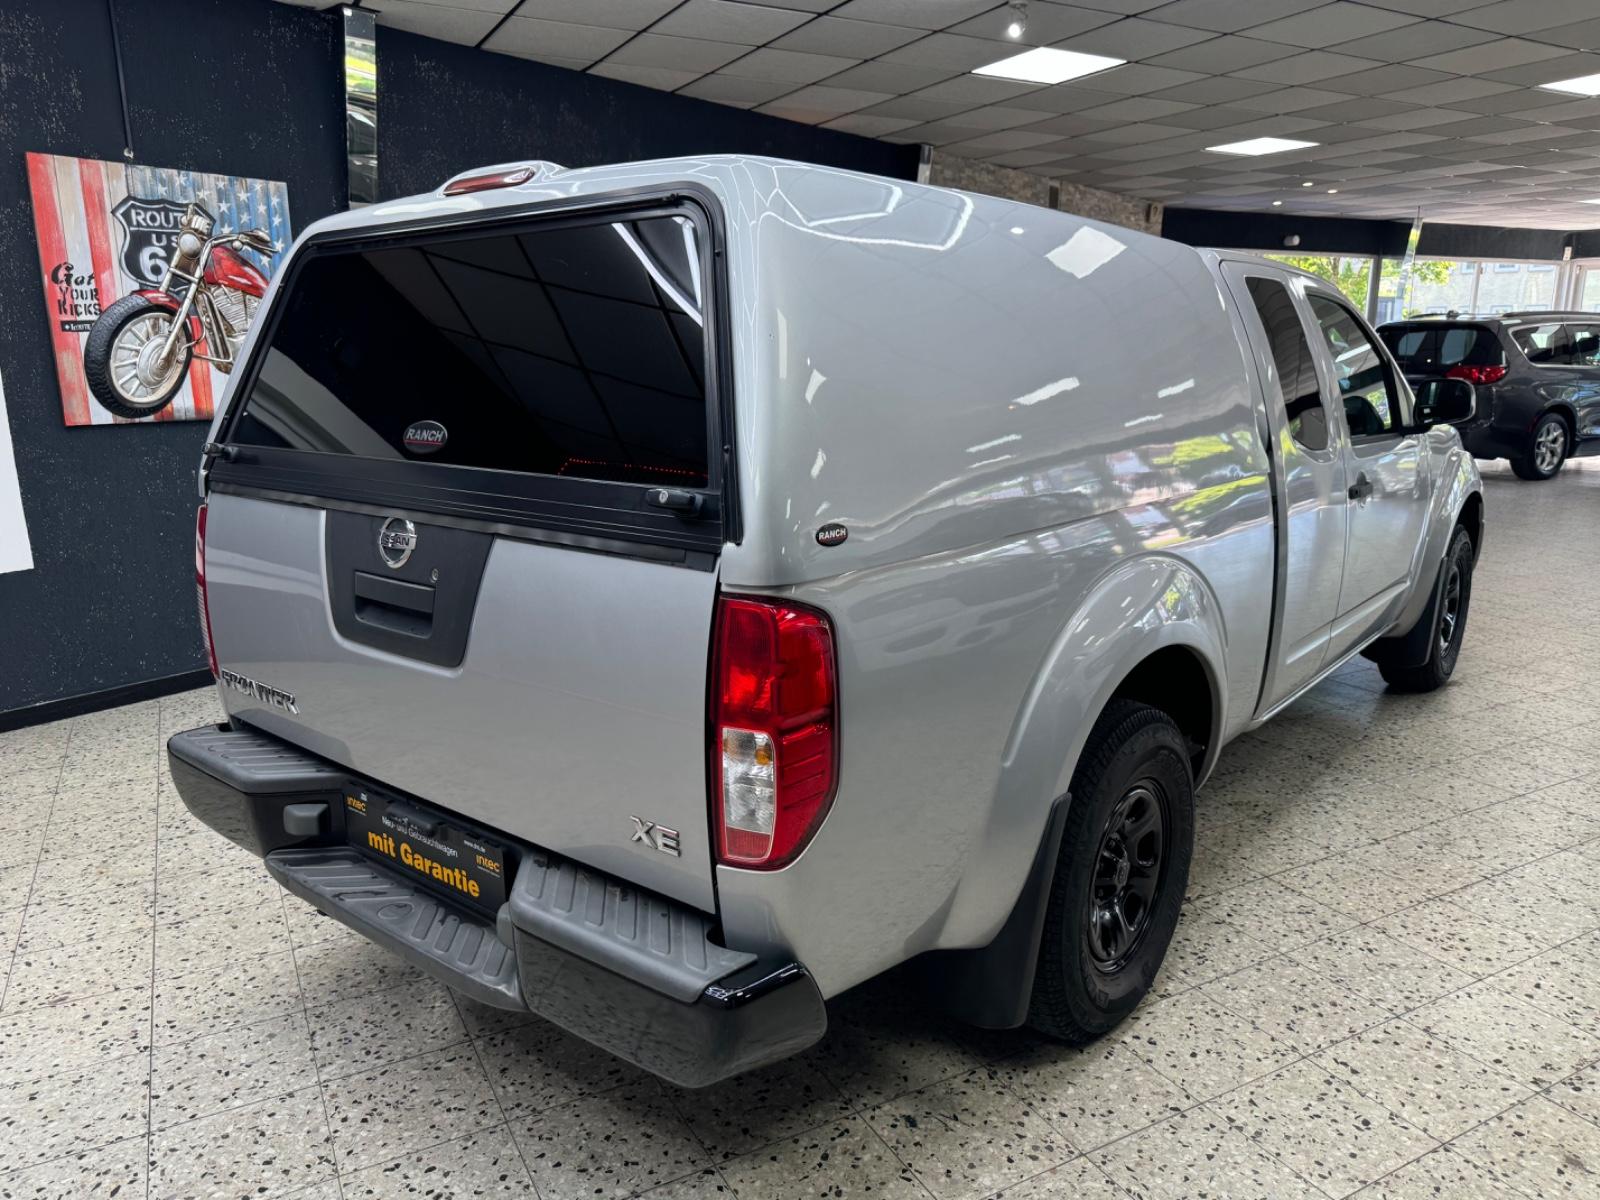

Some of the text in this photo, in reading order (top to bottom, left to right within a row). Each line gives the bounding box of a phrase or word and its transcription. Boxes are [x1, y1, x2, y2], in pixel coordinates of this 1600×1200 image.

[58, 286, 99, 301] YOUR
[57, 299, 102, 316] KICKS
[406, 428, 444, 442] RANCH
[818, 528, 846, 540] RANCH
[629, 815, 681, 857] XE
[368, 831, 480, 897] mit Garantie
